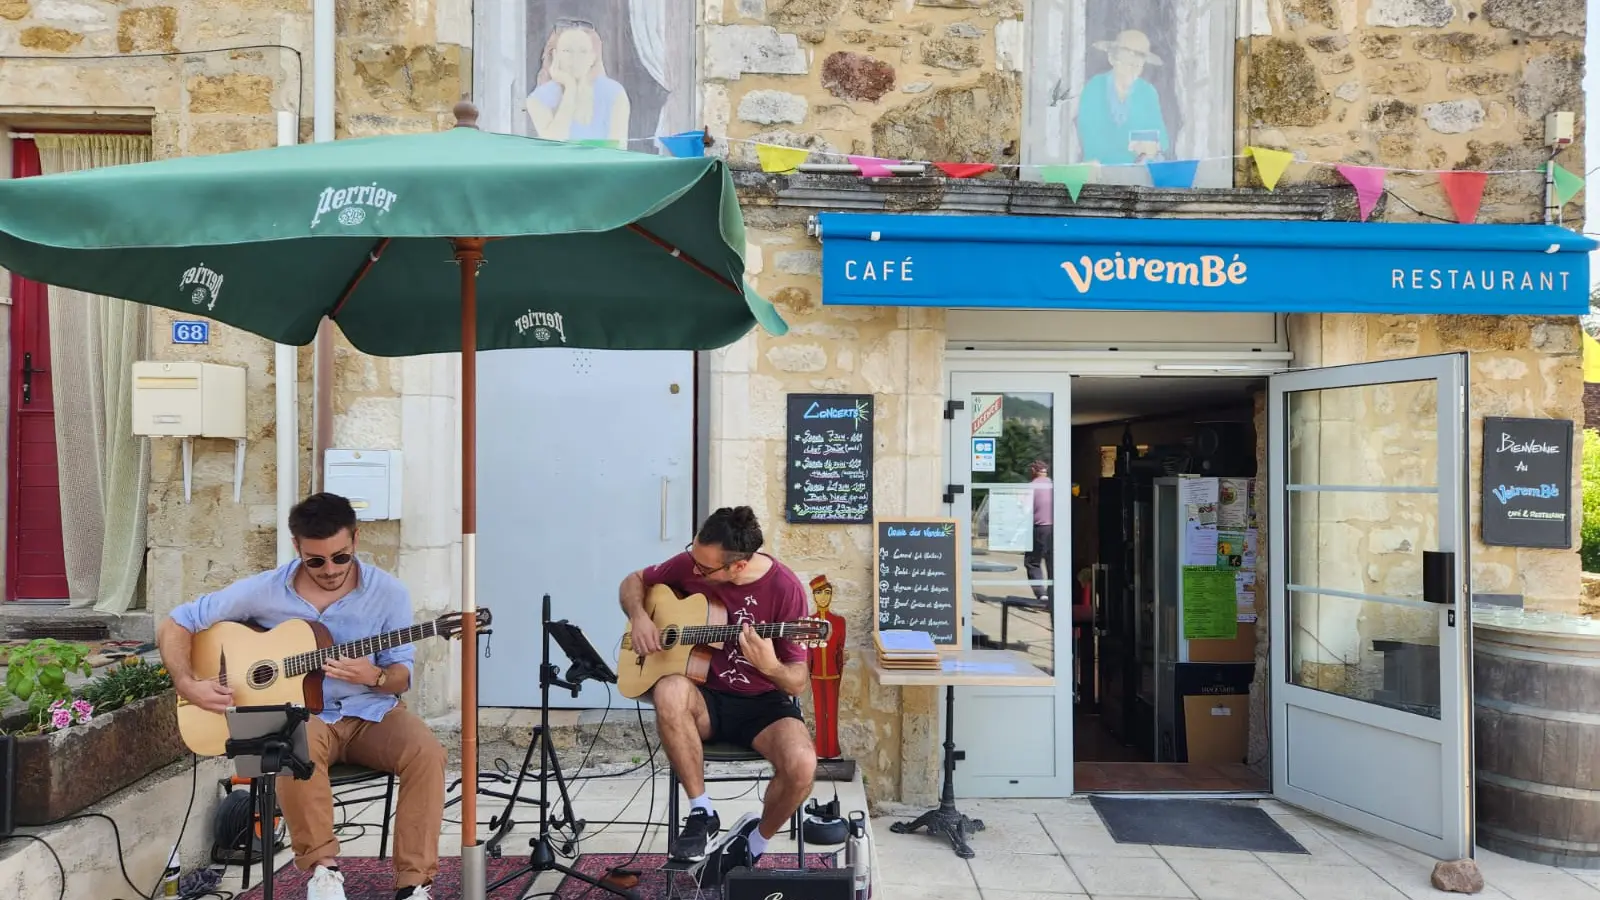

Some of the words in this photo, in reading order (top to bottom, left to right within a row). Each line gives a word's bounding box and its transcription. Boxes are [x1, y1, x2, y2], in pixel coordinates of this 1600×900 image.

[845, 256, 914, 281] CAFÉ
[1060, 251, 1247, 293] VeiremBé
[1391, 269, 1570, 291] RESTAURANT
[177, 324, 203, 341] 68
[974, 398, 1002, 430] LICENCE
